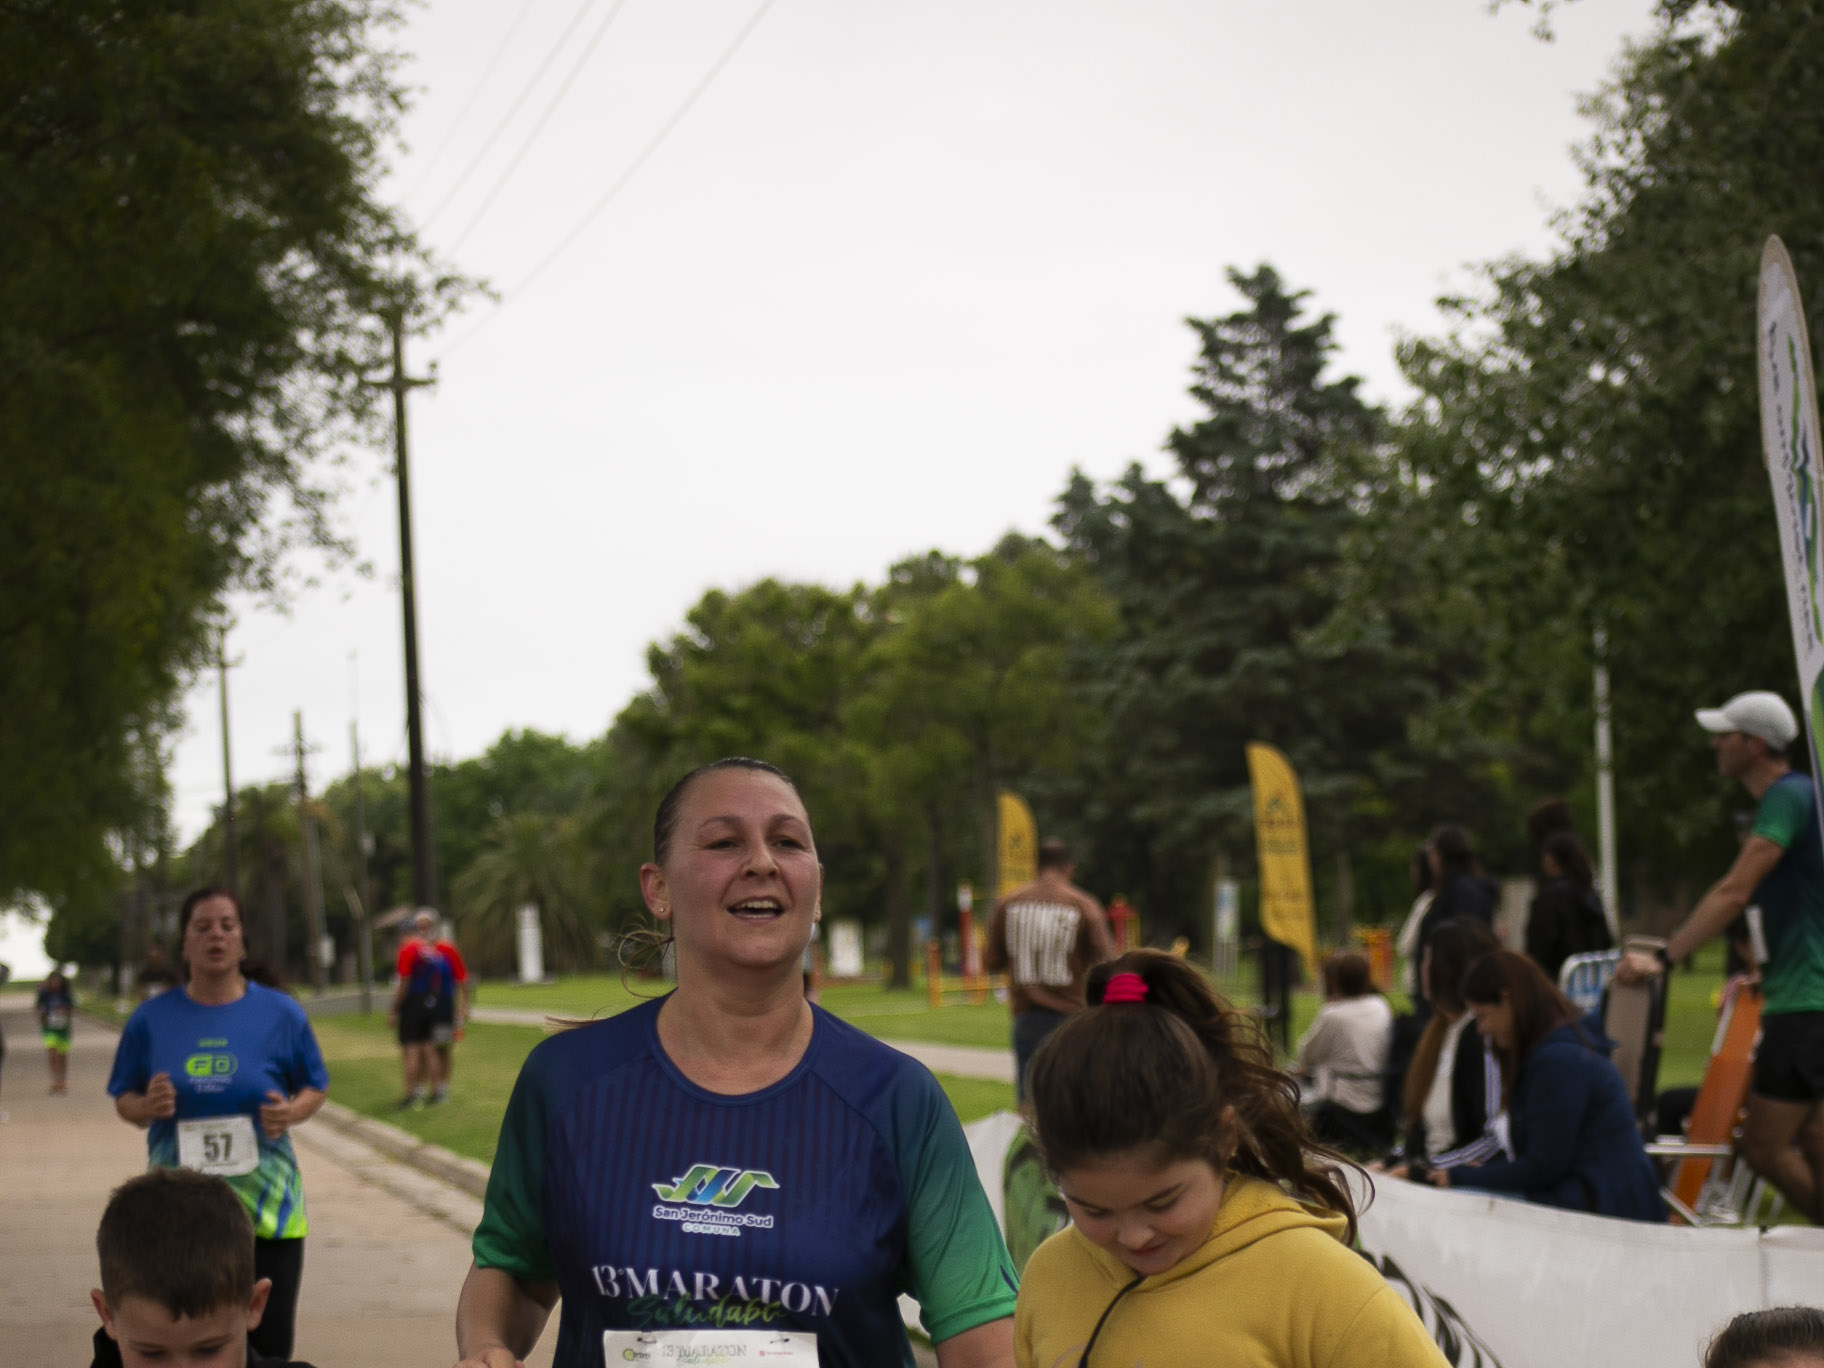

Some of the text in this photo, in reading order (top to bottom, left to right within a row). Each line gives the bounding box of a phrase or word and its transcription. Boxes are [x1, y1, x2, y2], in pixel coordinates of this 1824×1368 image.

[203, 1132, 233, 1161] 57
[654, 1203, 774, 1229] San Jerónimo Sud
[682, 1222, 741, 1237] COMUNA
